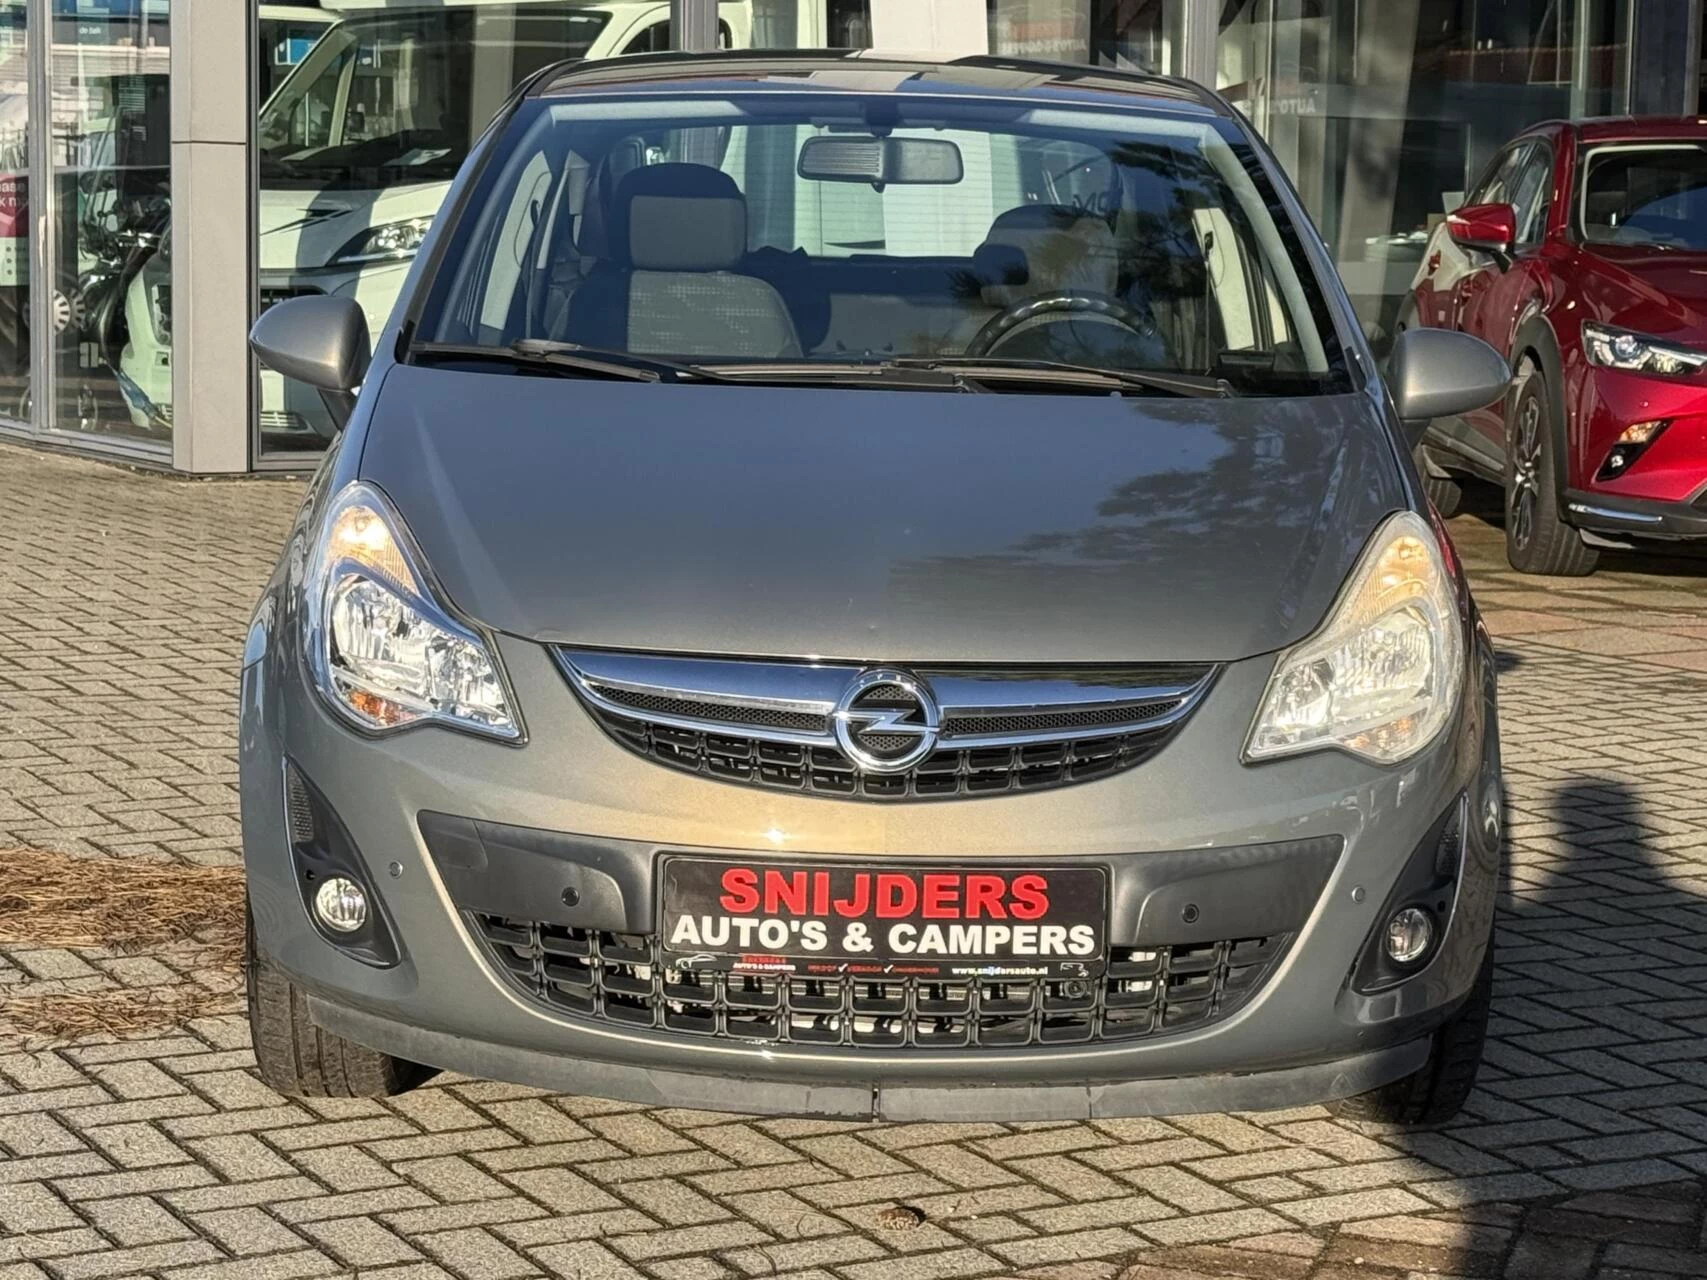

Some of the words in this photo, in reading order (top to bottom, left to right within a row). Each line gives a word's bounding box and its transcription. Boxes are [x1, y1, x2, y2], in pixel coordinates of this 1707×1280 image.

[720, 868, 1049, 920] SNIJDERS
[670, 914, 828, 951] AUTO'S
[842, 921, 874, 953] &
[888, 923, 1095, 955] CAMPERS
